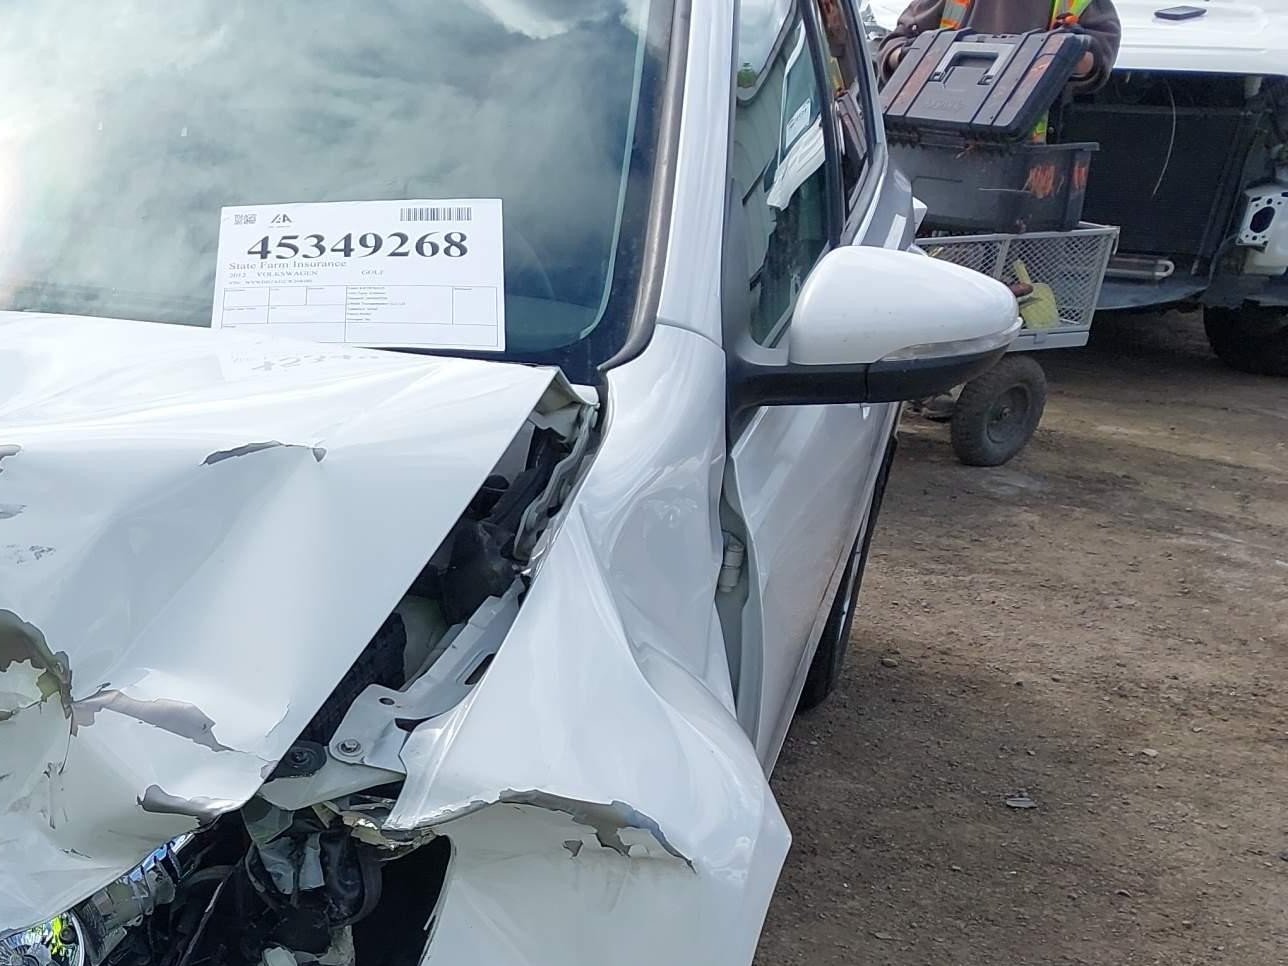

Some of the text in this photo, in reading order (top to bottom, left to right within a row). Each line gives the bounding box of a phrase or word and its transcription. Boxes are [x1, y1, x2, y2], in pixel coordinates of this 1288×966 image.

[247, 232, 469, 260] 45349268
[228, 259, 347, 270] State Farm Insurance
